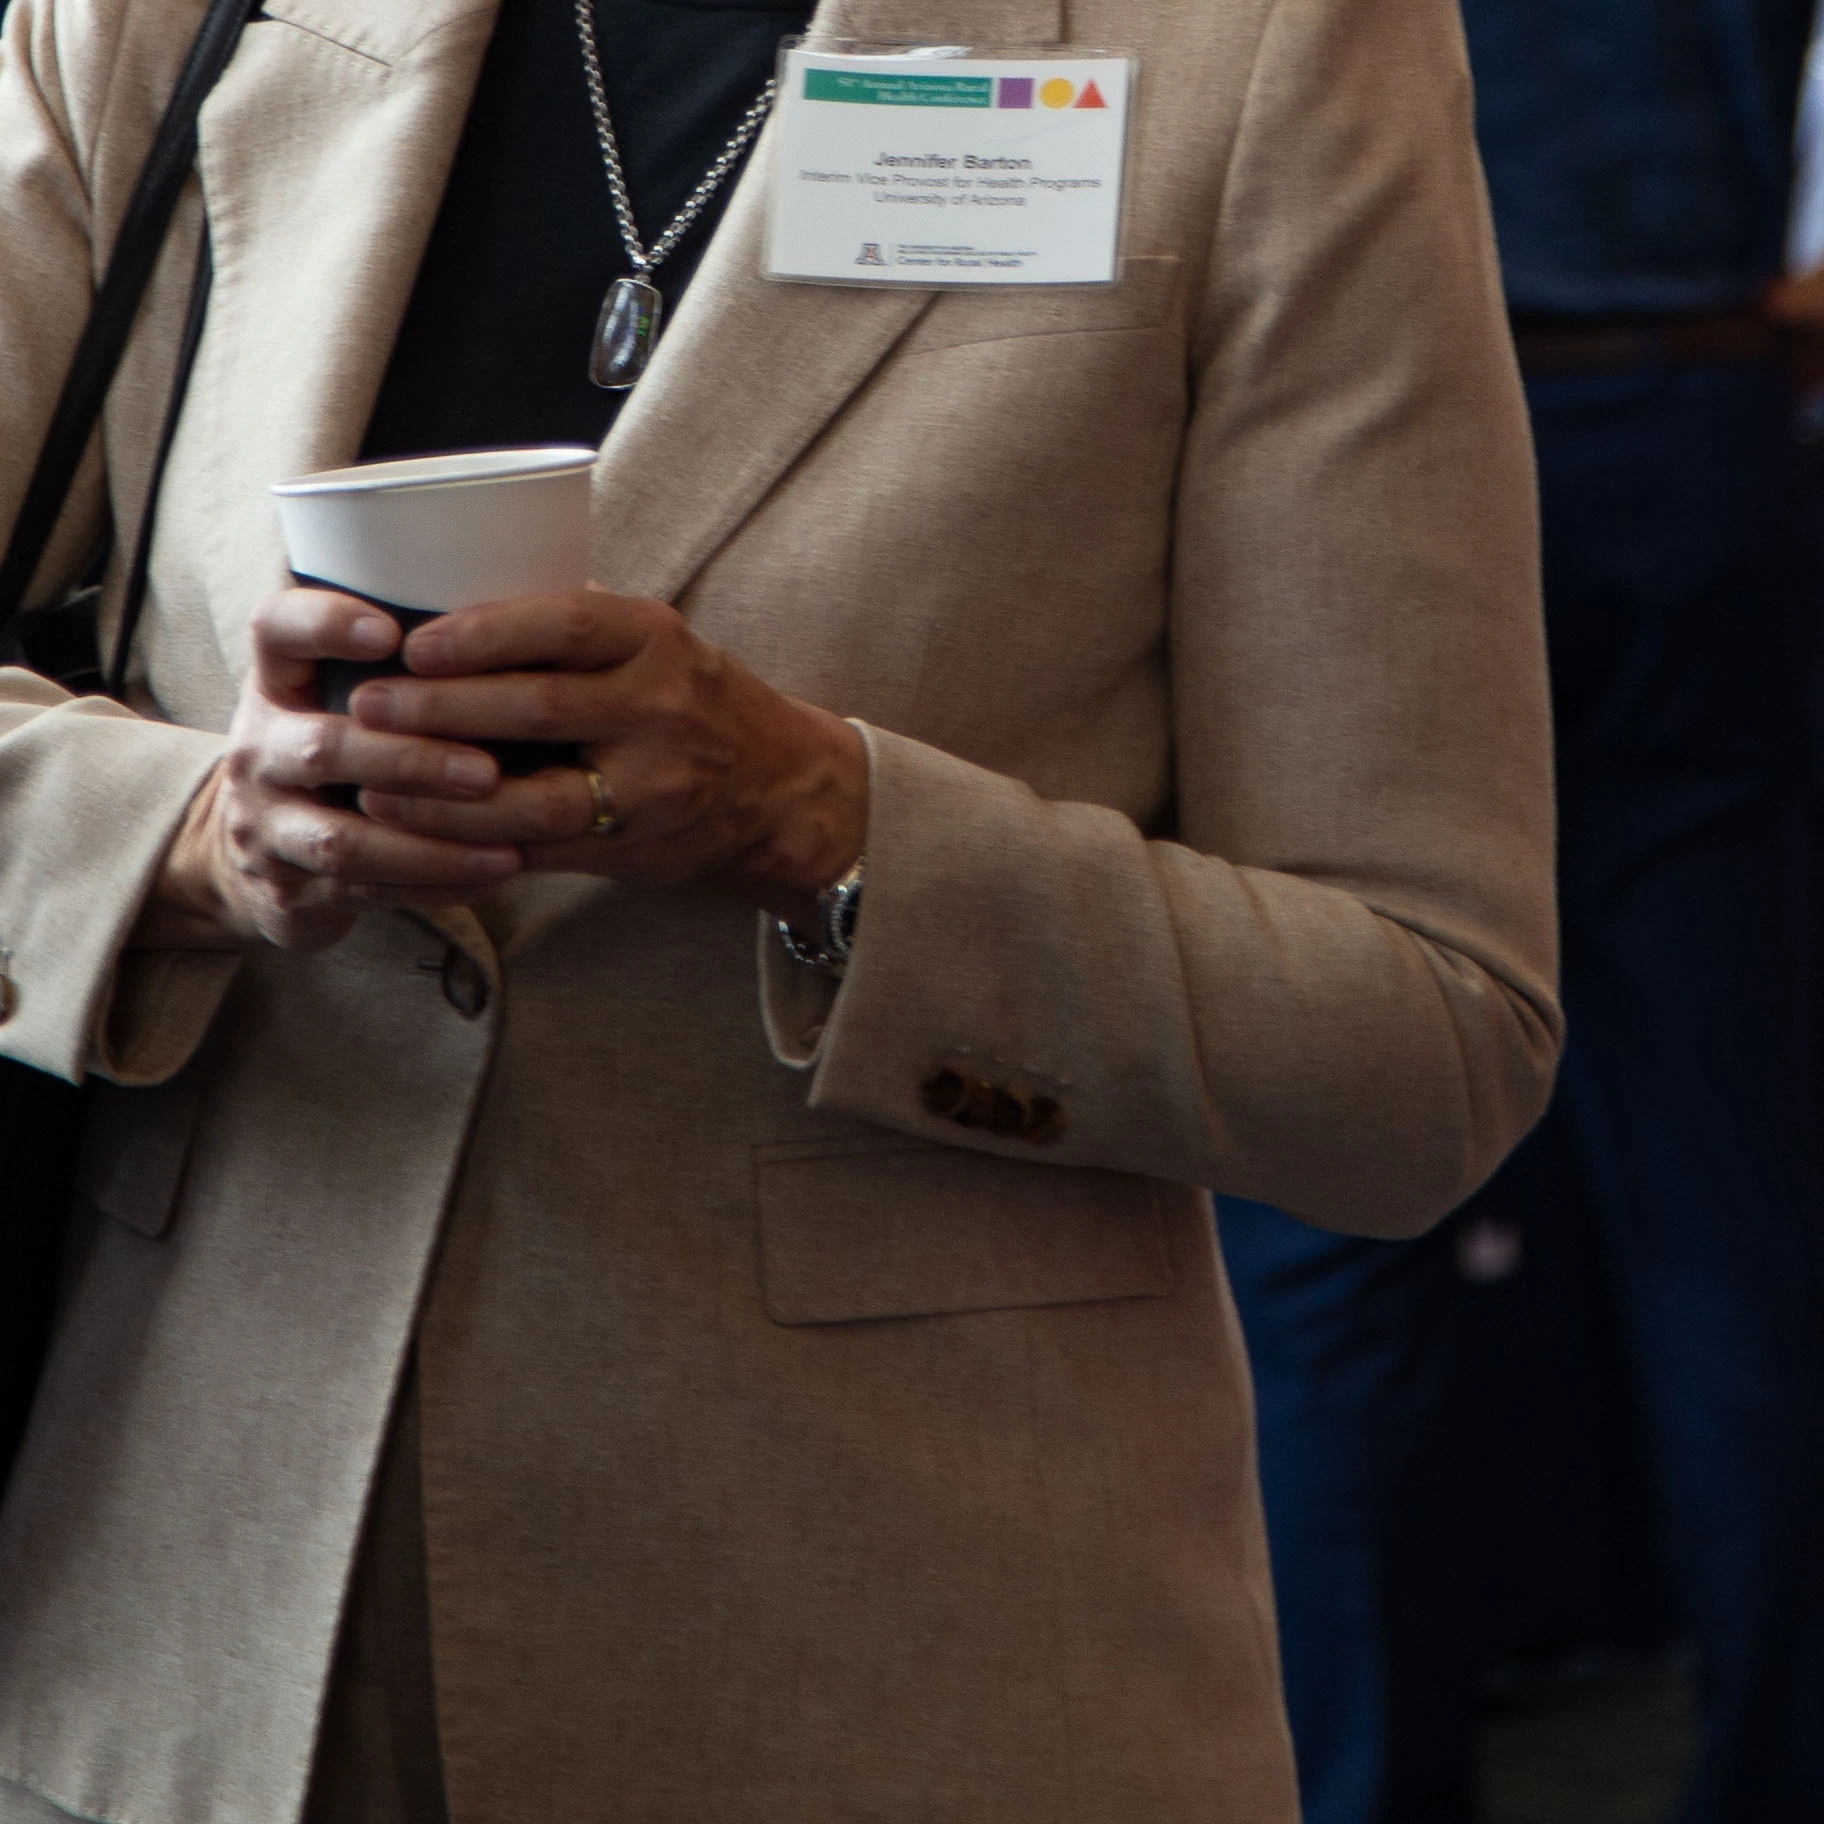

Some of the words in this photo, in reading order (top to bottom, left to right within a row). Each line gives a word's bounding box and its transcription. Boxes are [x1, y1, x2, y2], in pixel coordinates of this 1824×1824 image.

[873, 152, 958, 169] Jennifer
[963, 155, 1032, 170] Barton
[856, 172, 887, 185] Vice
[892, 174, 949, 188] Provost
[954, 176, 974, 188] for
[978, 176, 1025, 189] Health
[1030, 177, 1102, 192] Programs
[873, 190, 946, 207] University
[951, 193, 967, 206] of
[970, 194, 1026, 206] Arizona
